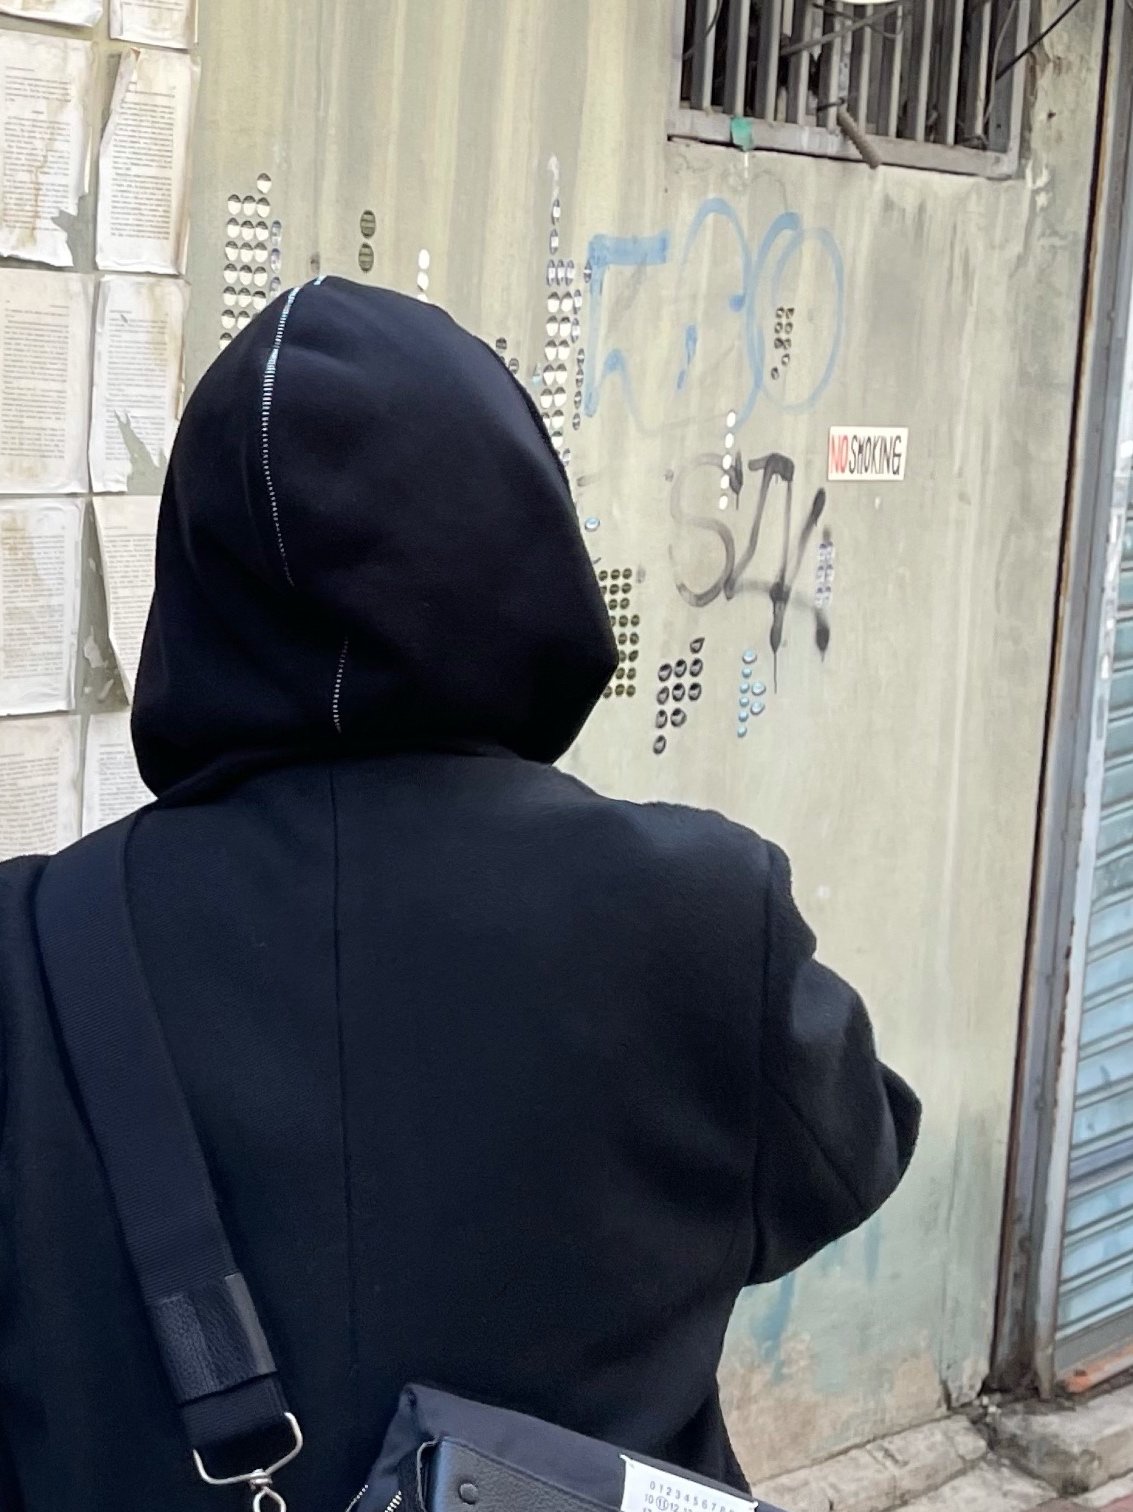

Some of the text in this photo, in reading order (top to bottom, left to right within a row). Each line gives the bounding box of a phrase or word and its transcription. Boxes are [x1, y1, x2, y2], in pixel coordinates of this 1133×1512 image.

[831, 434, 902, 475] NO SMOKING
[644, 1494, 654, 1504] 10
[657, 1497, 668, 1510] 11
[669, 1503, 679, 1512] 12
[650, 1481, 656, 1490] 0
[660, 1484, 663, 1493] 1
[666, 1486, 672, 1495] 2
[675, 1490, 681, 1499] 3
[684, 1493, 690, 1502] 4
[693, 1496, 698, 1506] 5
[702, 1499, 707, 1509] 6
[711, 1503, 716, 1511] 7
